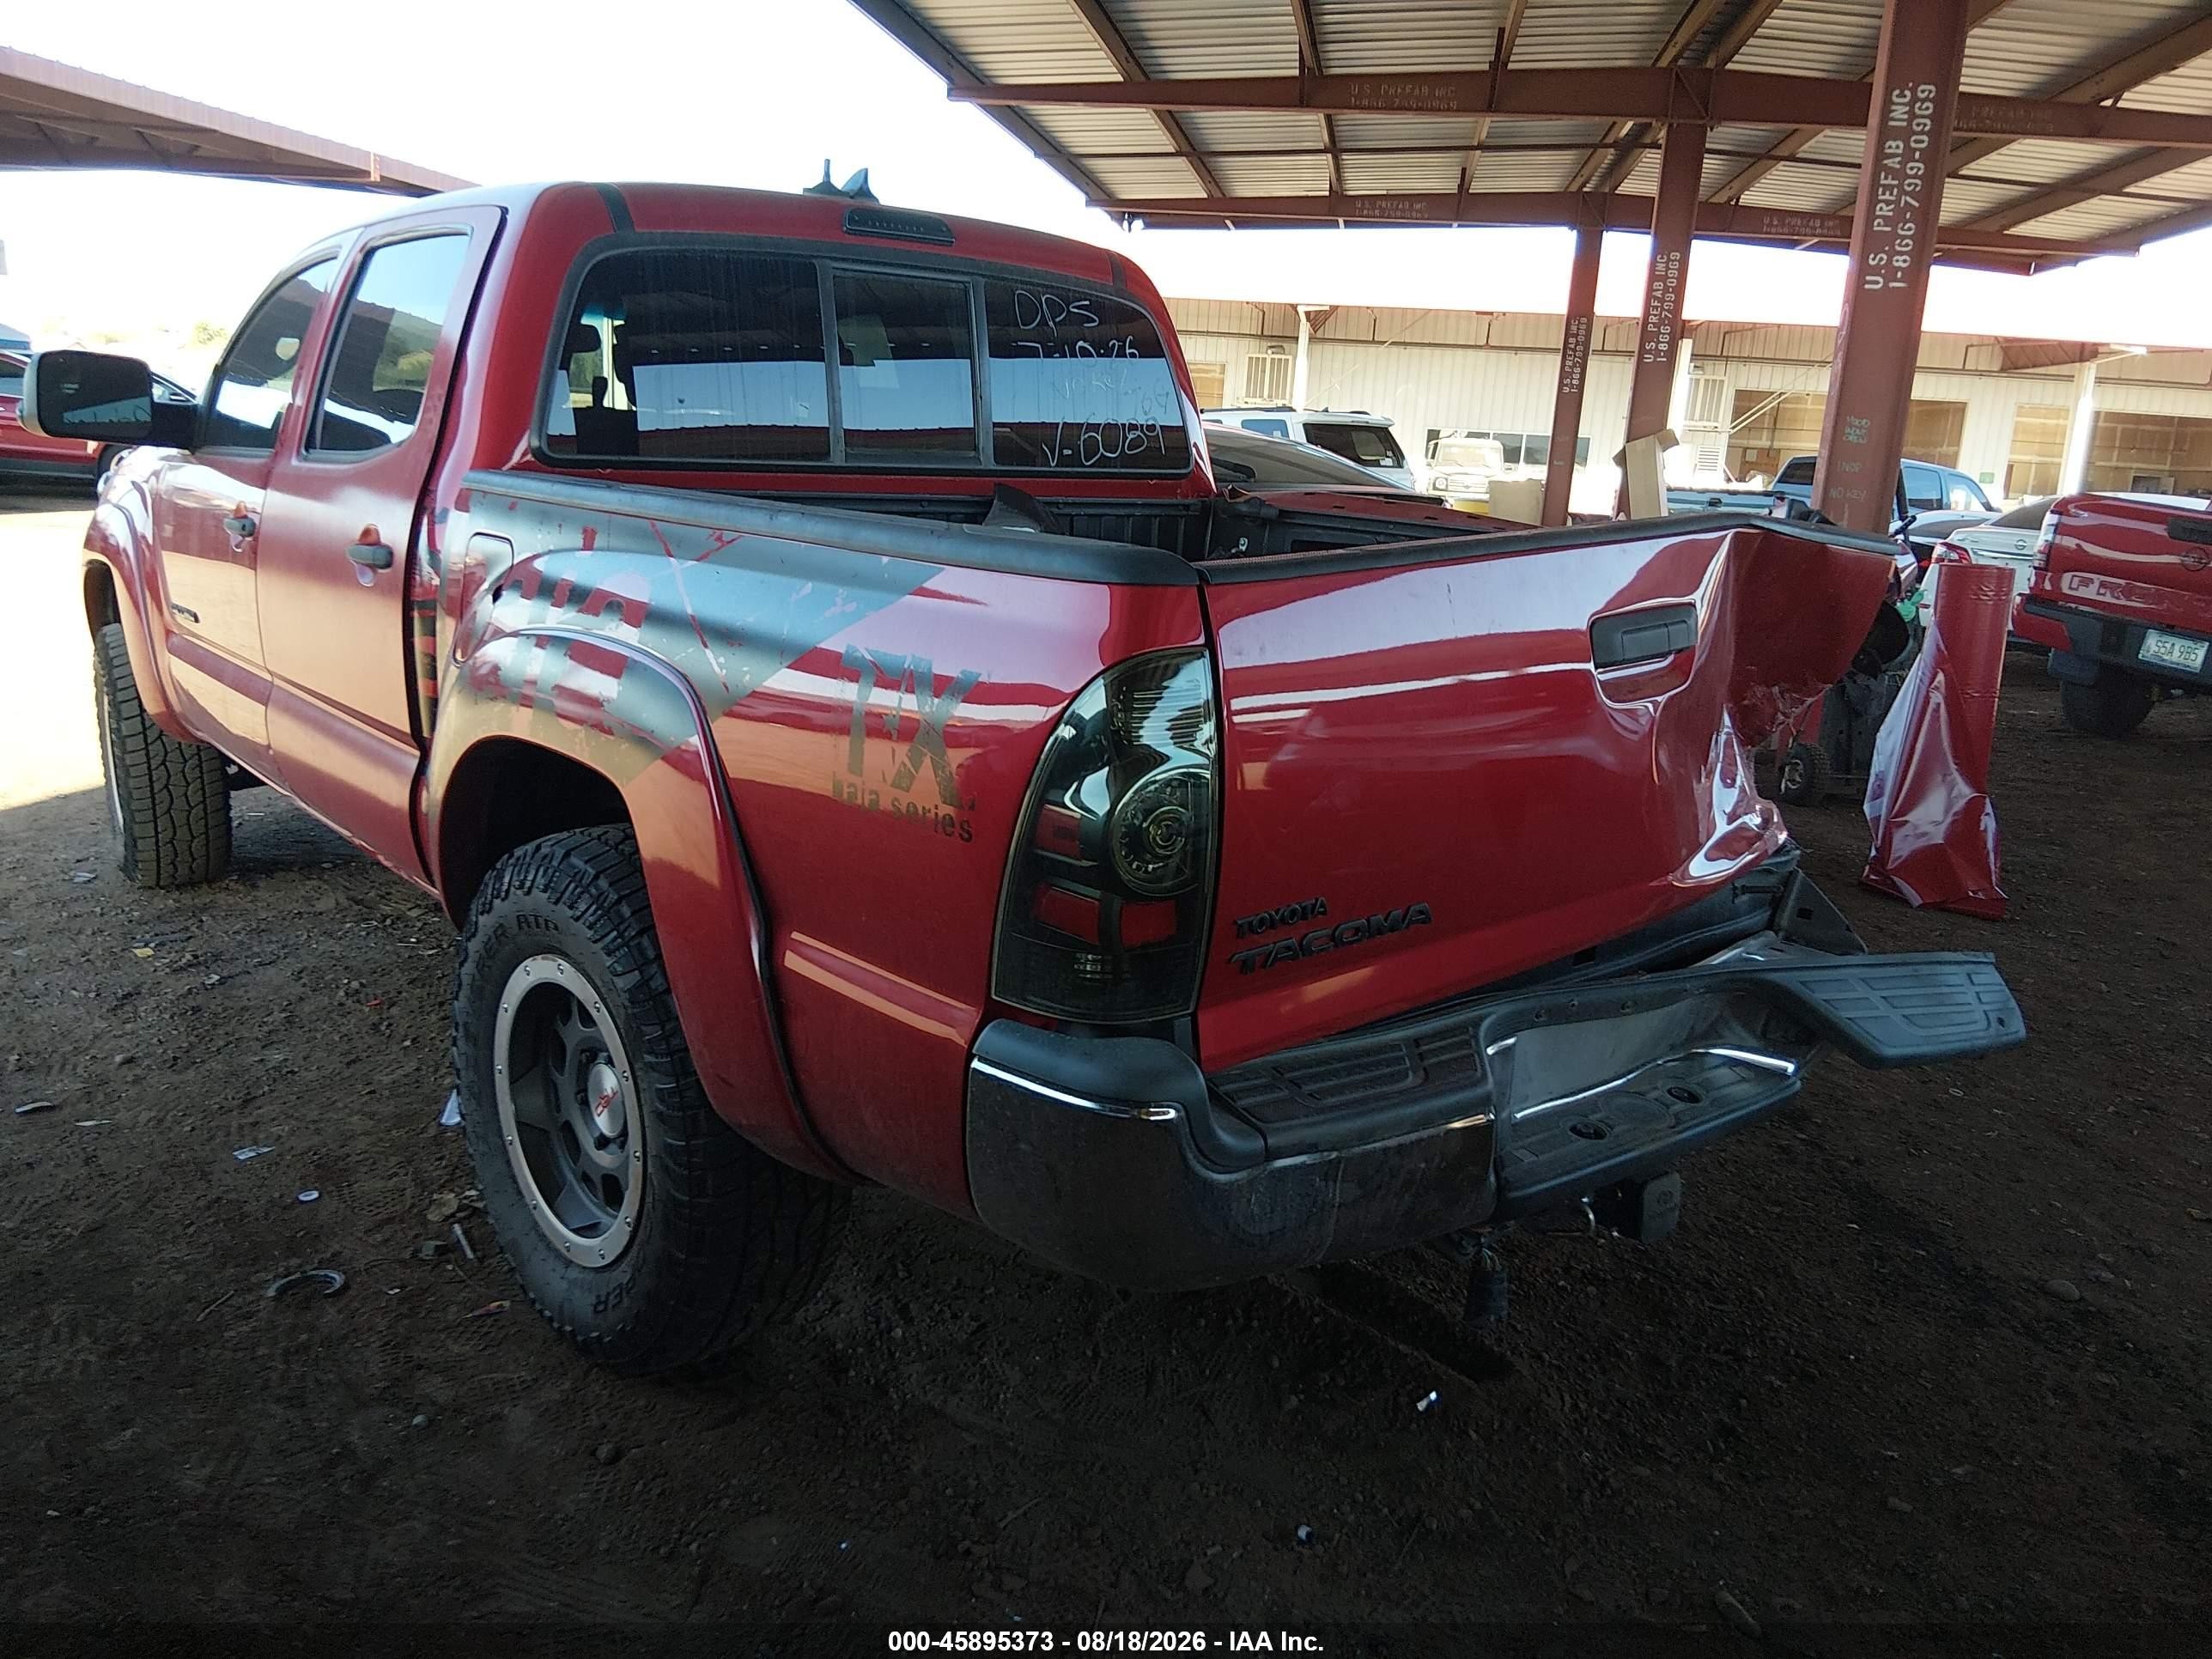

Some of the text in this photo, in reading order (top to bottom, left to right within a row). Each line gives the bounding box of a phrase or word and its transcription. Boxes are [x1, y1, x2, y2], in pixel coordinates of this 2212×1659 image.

[1864, 82, 1913, 290] U.S. PREFAB INC.
[1889, 83, 1936, 289] 1-866-799-0969
[1014, 289, 1099, 337] DPS
[1647, 281, 1664, 331] PREFAB
[1656, 252, 1680, 362] 1-866-799-0969
[1564, 336, 1577, 372] PREFAB
[1643, 337, 1657, 362] U.S.
[1562, 375, 1572, 393] U.S.
[890, 796, 973, 843] series
[1227, 901, 1432, 975] TACOMA
[1233, 896, 1328, 939] TOYOTA
